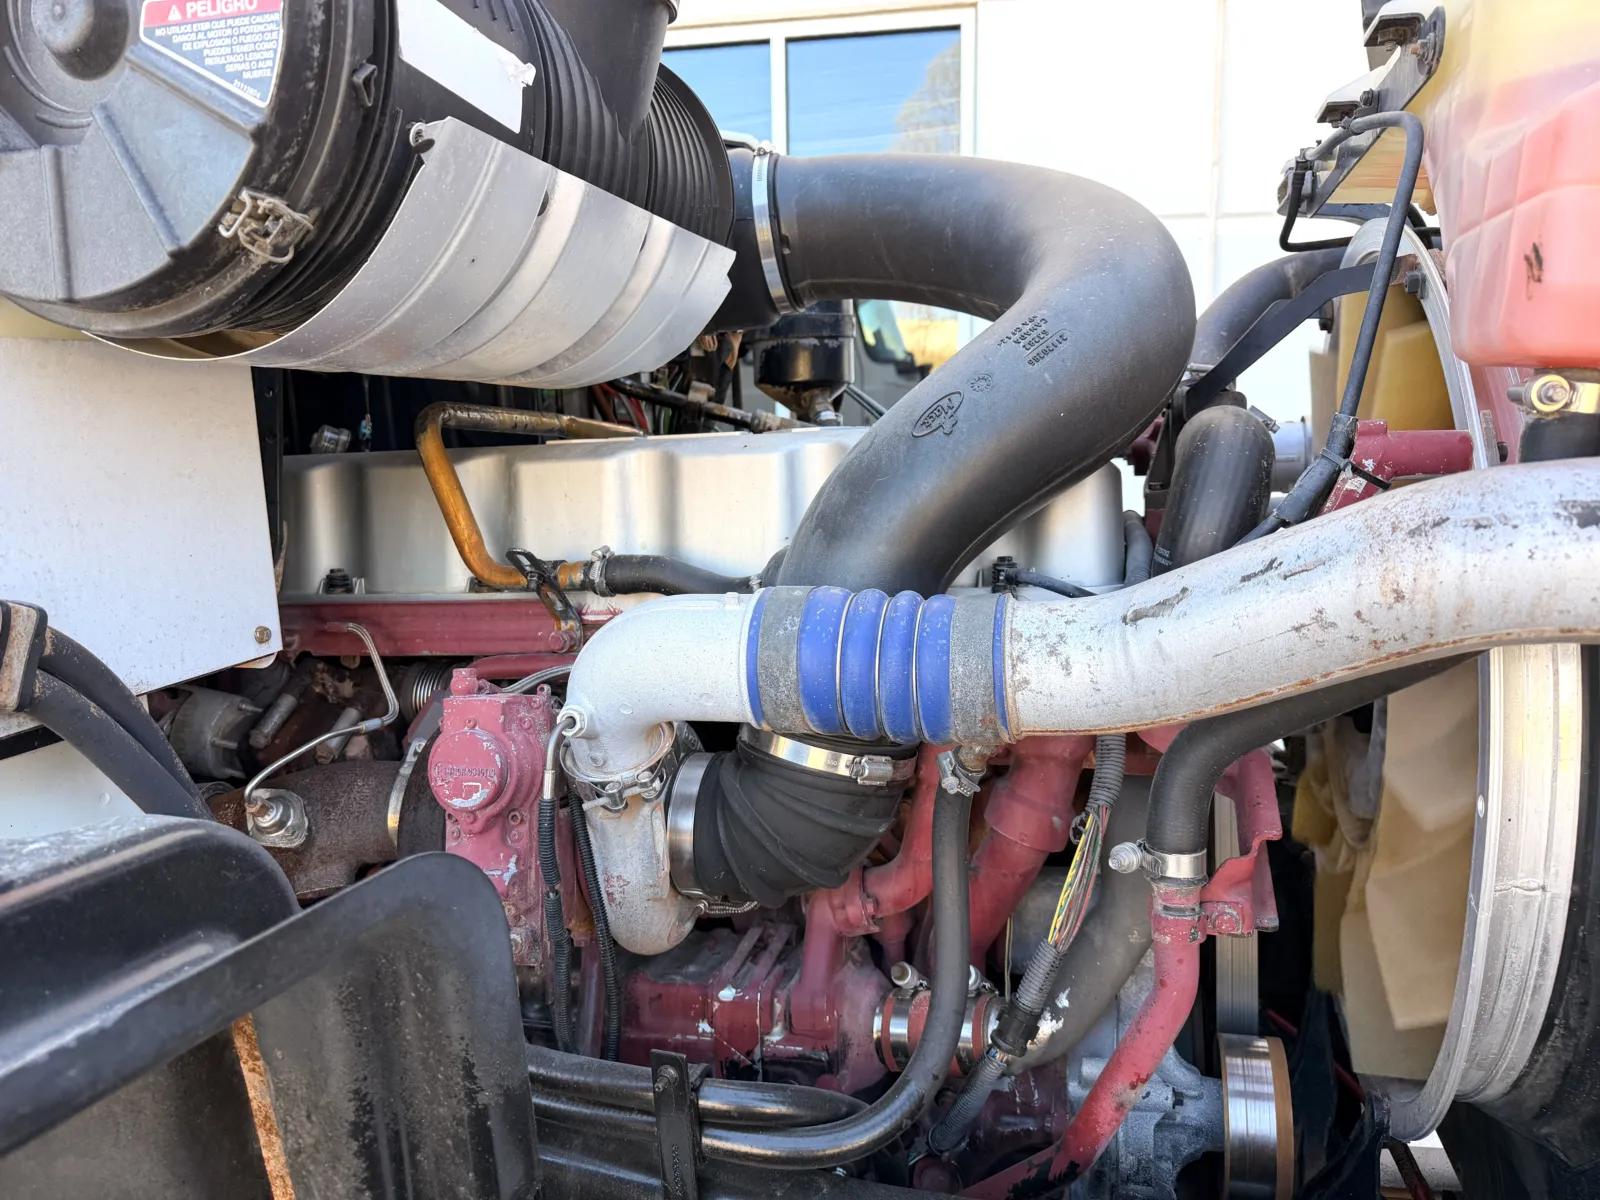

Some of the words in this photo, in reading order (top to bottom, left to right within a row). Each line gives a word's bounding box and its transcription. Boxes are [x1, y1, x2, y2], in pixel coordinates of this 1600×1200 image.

[186, 0, 257, 18] PELIGRO
[155, 28, 166, 36] NO
[211, 20, 226, 29] QUE
[227, 17, 250, 26] PUEDE
[250, 12, 280, 24] CAUSAR
[197, 31, 207, 40] AL
[207, 28, 232, 39] MOTOR
[232, 27, 239, 35] O
[183, 42, 193, 51] DE
[232, 36, 238, 44] O
[239, 32, 262, 43] FUEGO
[263, 30, 279, 41] QUE
[255, 40, 277, 51] COMO
[1012, 318, 1049, 345] CANADA
